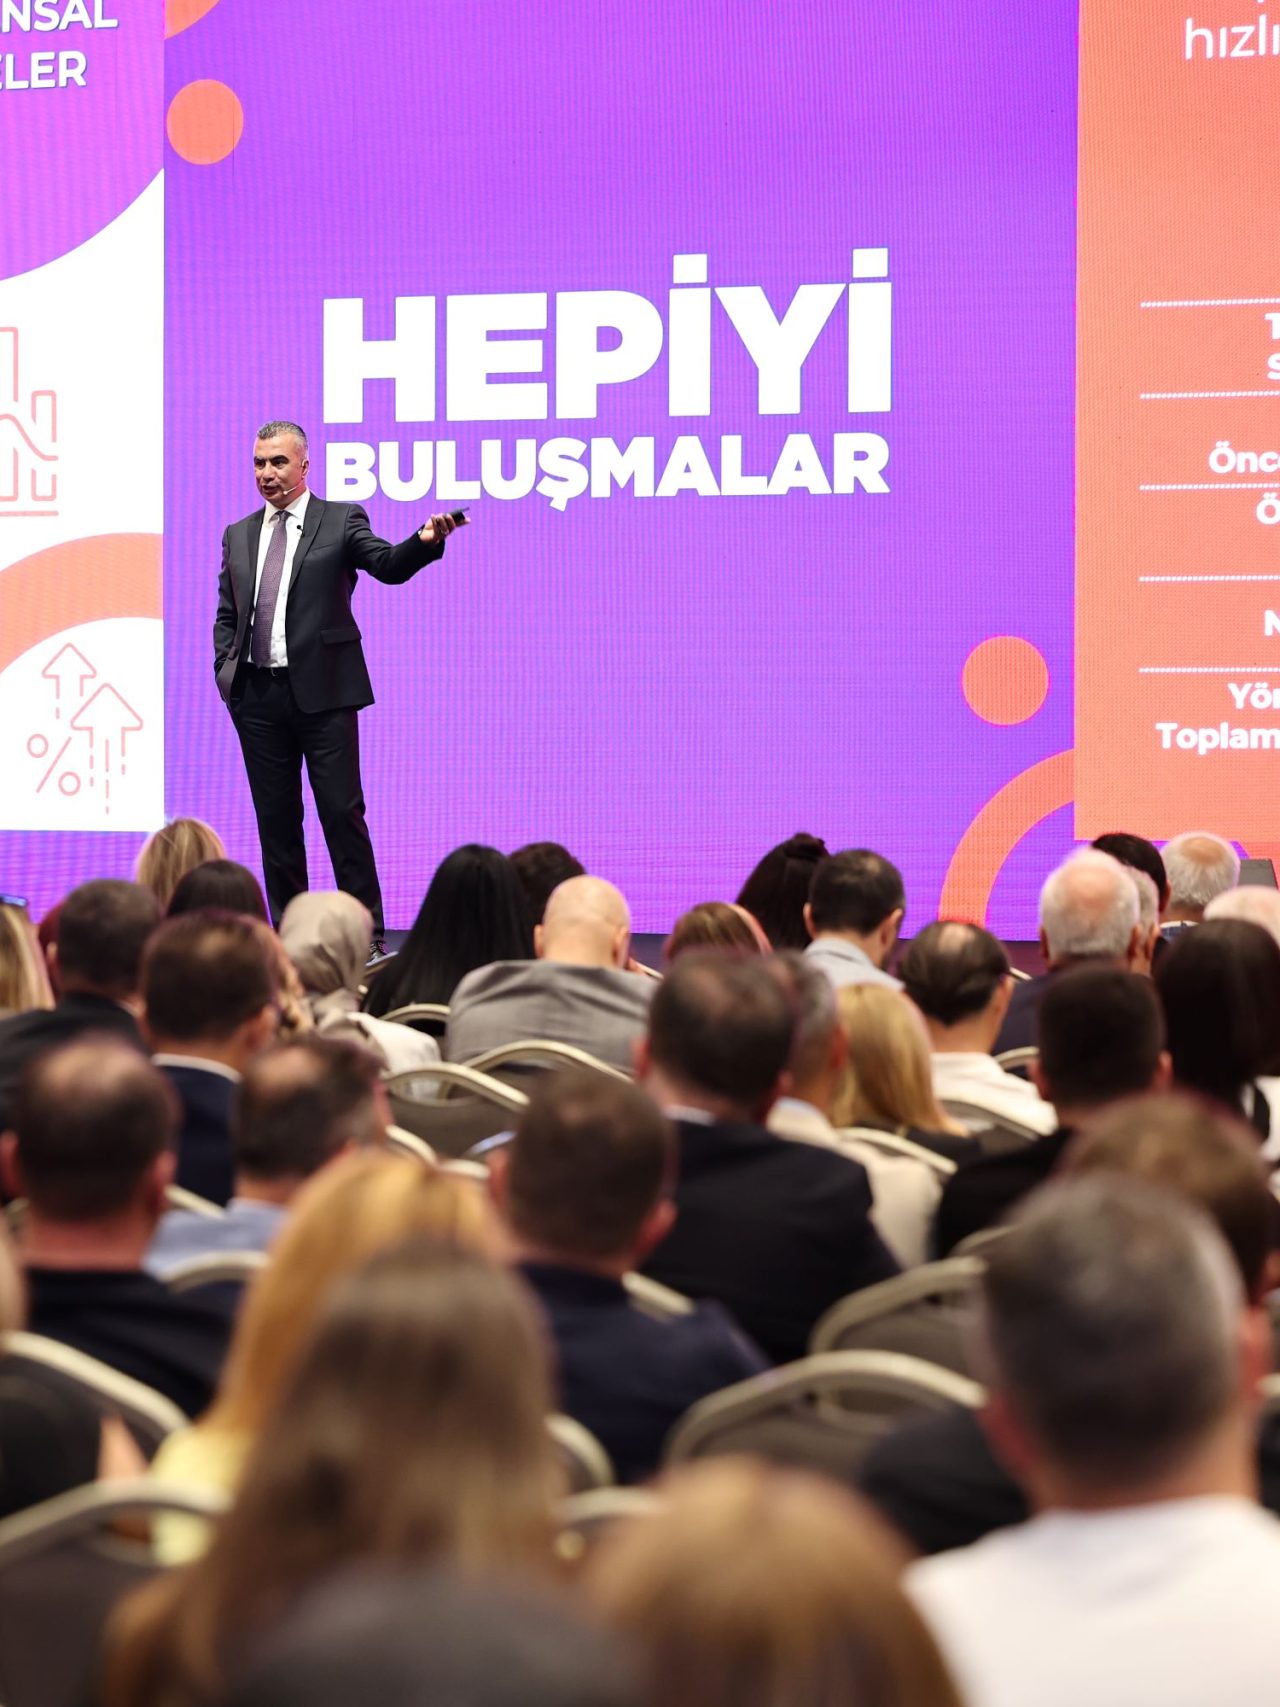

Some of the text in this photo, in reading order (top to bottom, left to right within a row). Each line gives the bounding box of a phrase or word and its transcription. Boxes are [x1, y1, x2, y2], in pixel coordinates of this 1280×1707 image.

[1184, 13, 1280, 61] hızlı
[323, 247, 893, 424] HEPİYİ
[325, 432, 892, 512] BULUŞMALAR
[1207, 439, 1280, 475] Önc
[1154, 720, 1280, 756] Toplam
